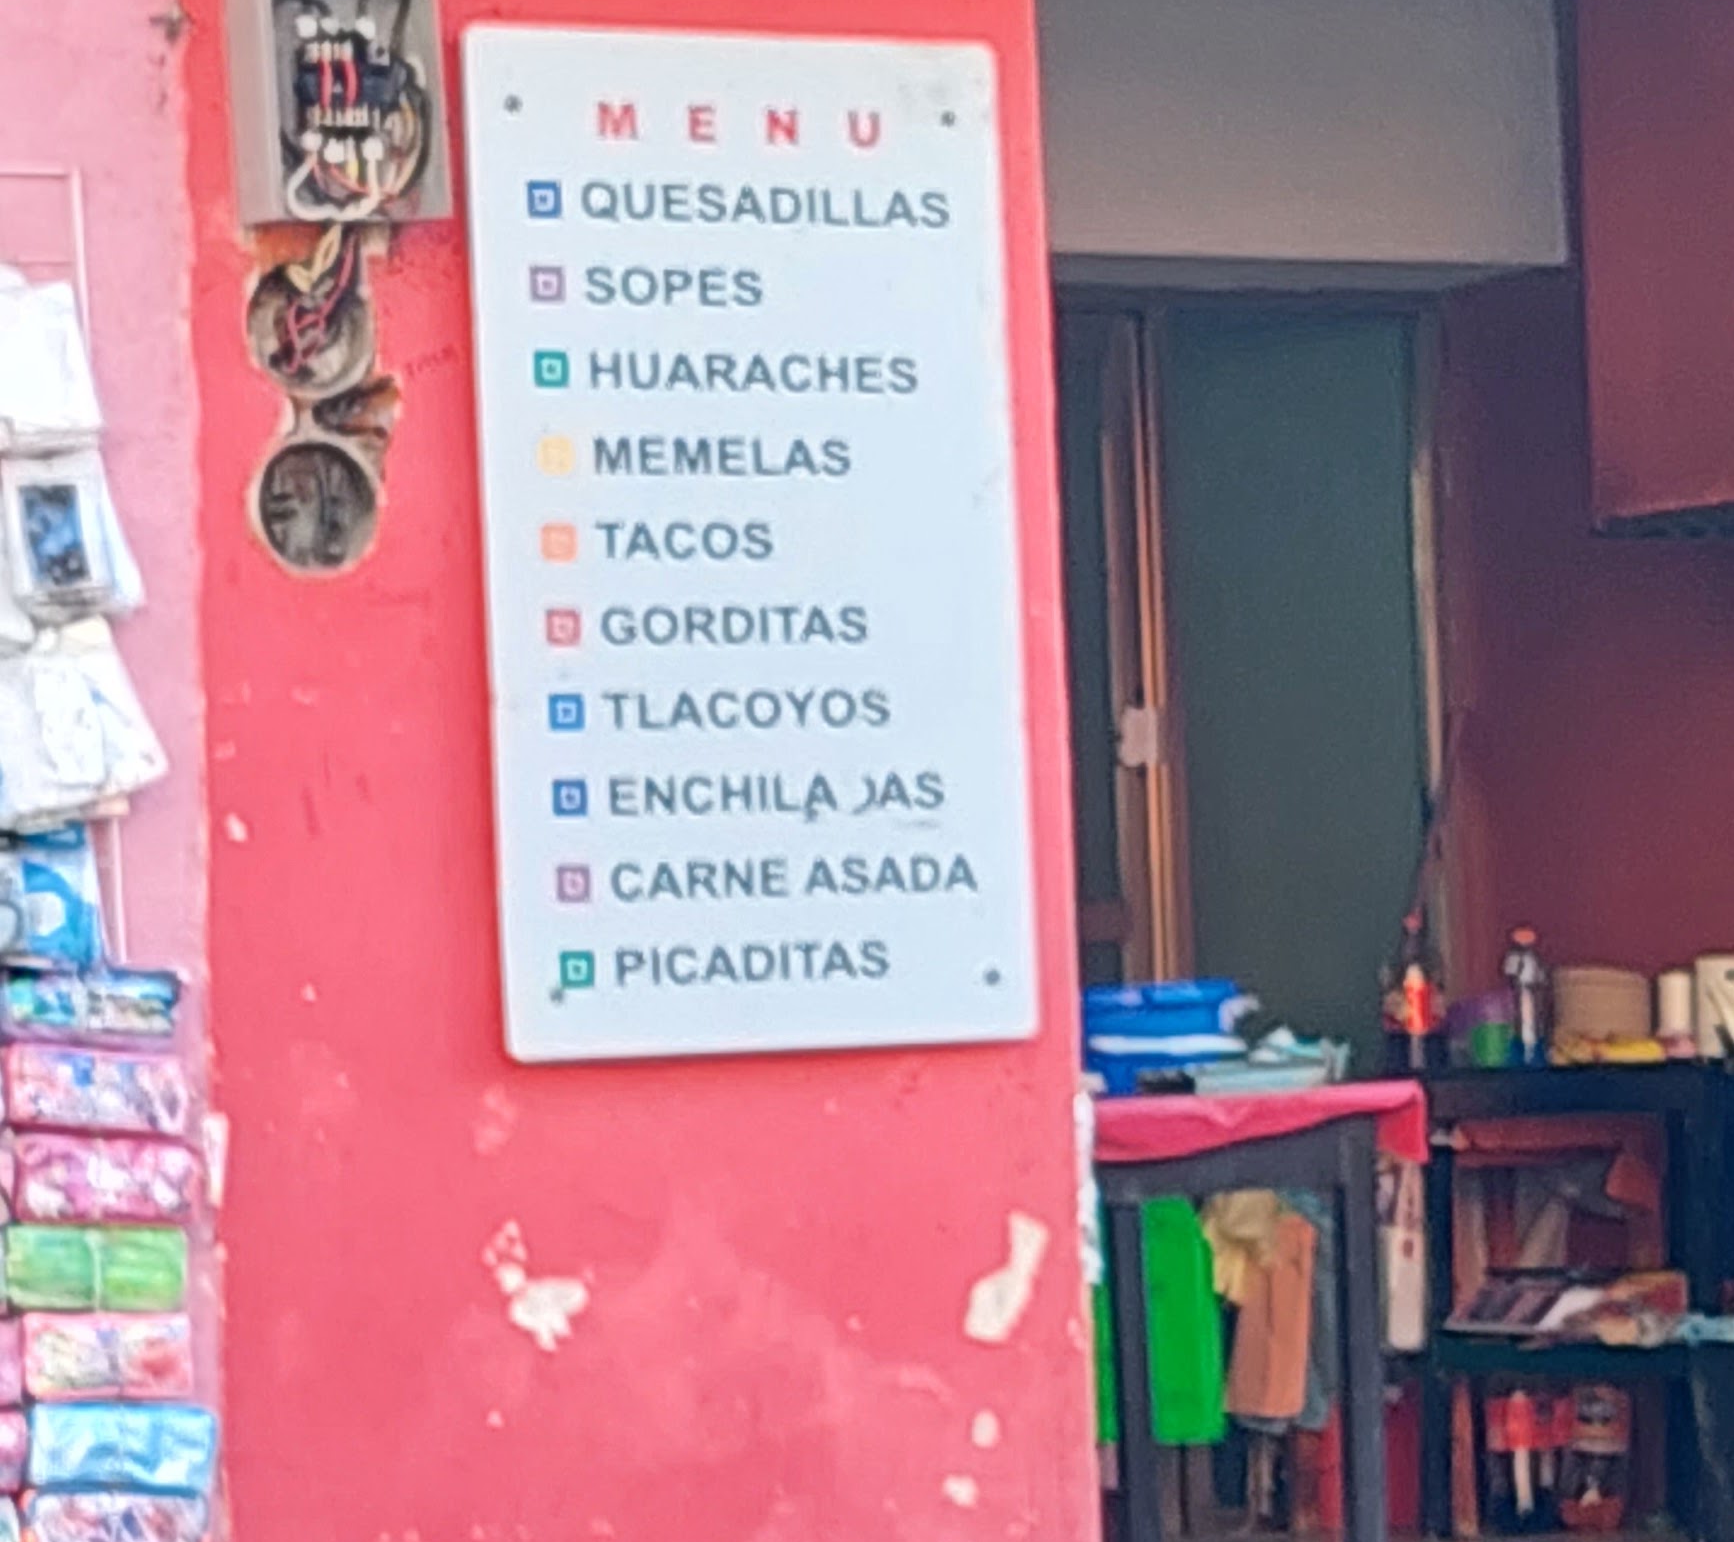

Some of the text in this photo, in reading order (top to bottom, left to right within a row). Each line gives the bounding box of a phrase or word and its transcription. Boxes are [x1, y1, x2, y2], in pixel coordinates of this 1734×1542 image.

[581, 181, 950, 229] QUESADILLAS
[584, 267, 763, 307] SOPES
[588, 352, 919, 395] HUARACHES
[593, 435, 852, 477] MEMELAS
[595, 520, 774, 561] TACOS
[600, 605, 868, 646] GORDITAS
[600, 688, 891, 730] TLACOYOS
[610, 854, 979, 902] CARNE ASADA
[614, 939, 891, 986] PICADITAS
